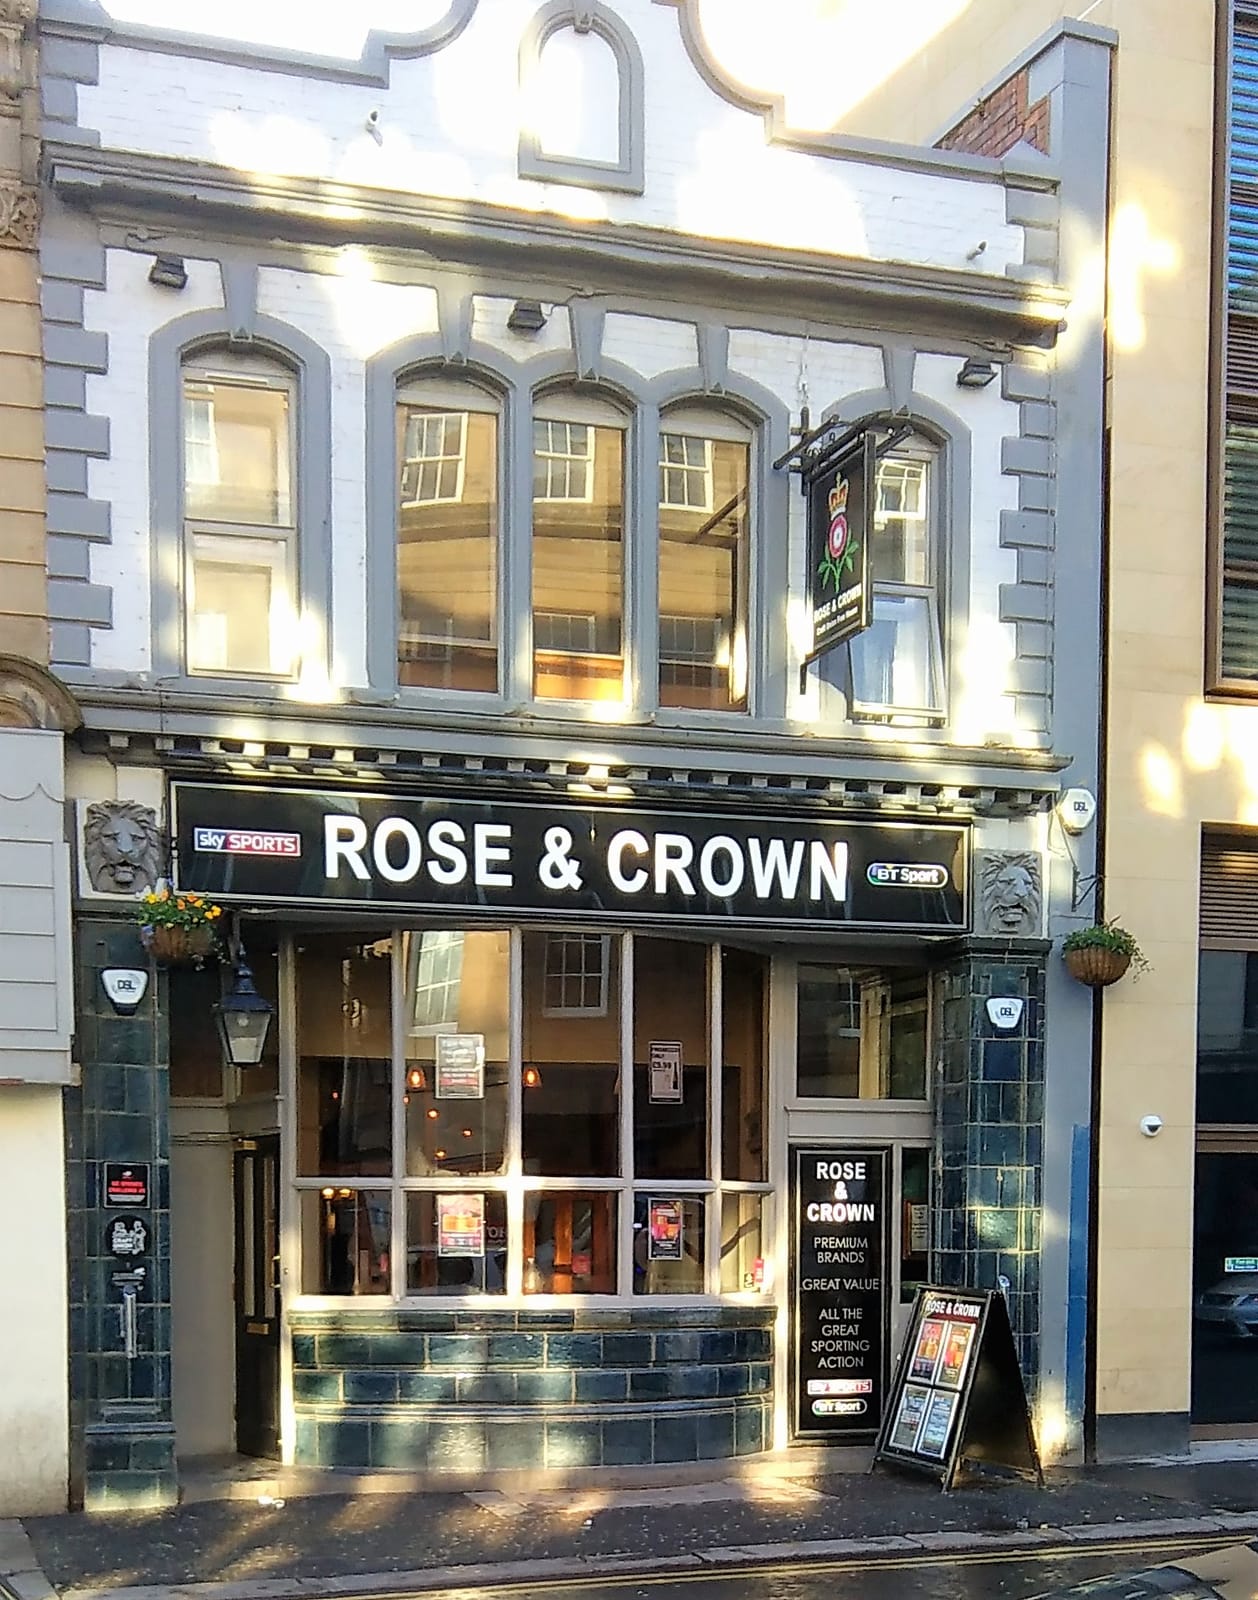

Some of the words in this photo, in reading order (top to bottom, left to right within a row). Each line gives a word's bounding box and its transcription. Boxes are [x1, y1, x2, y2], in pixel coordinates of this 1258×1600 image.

[814, 602, 831, 623] ROSE
[837, 582, 862, 609] CROWN
[199, 831, 226, 850] sky
[228, 833, 296, 852] SPORTS
[323, 813, 514, 888] ROSE
[538, 825, 584, 892] &
[607, 828, 849, 903] CROWN
[877, 867, 900, 881] BT
[900, 868, 939, 884] Sport
[816, 1161, 867, 1180] ROSE
[834, 1180, 849, 1200] &
[806, 1202, 875, 1222] CROWN
[813, 1236, 869, 1249] PREMIUM
[816, 1251, 865, 1264] BRANDS
[801, 1278, 841, 1291] GREAT
[842, 1277, 880, 1290] VALUE
[818, 1308, 840, 1320] ALL
[841, 1307, 863, 1319] THE
[924, 1300, 946, 1314] ROSE
[945, 1302, 953, 1315] &
[953, 1303, 982, 1318] CROWN
[821, 1324, 860, 1336] GREAT
[810, 1339, 871, 1353] SPORTING
[817, 1355, 864, 1369] ACTION
[834, 1401, 860, 1413] Sport
